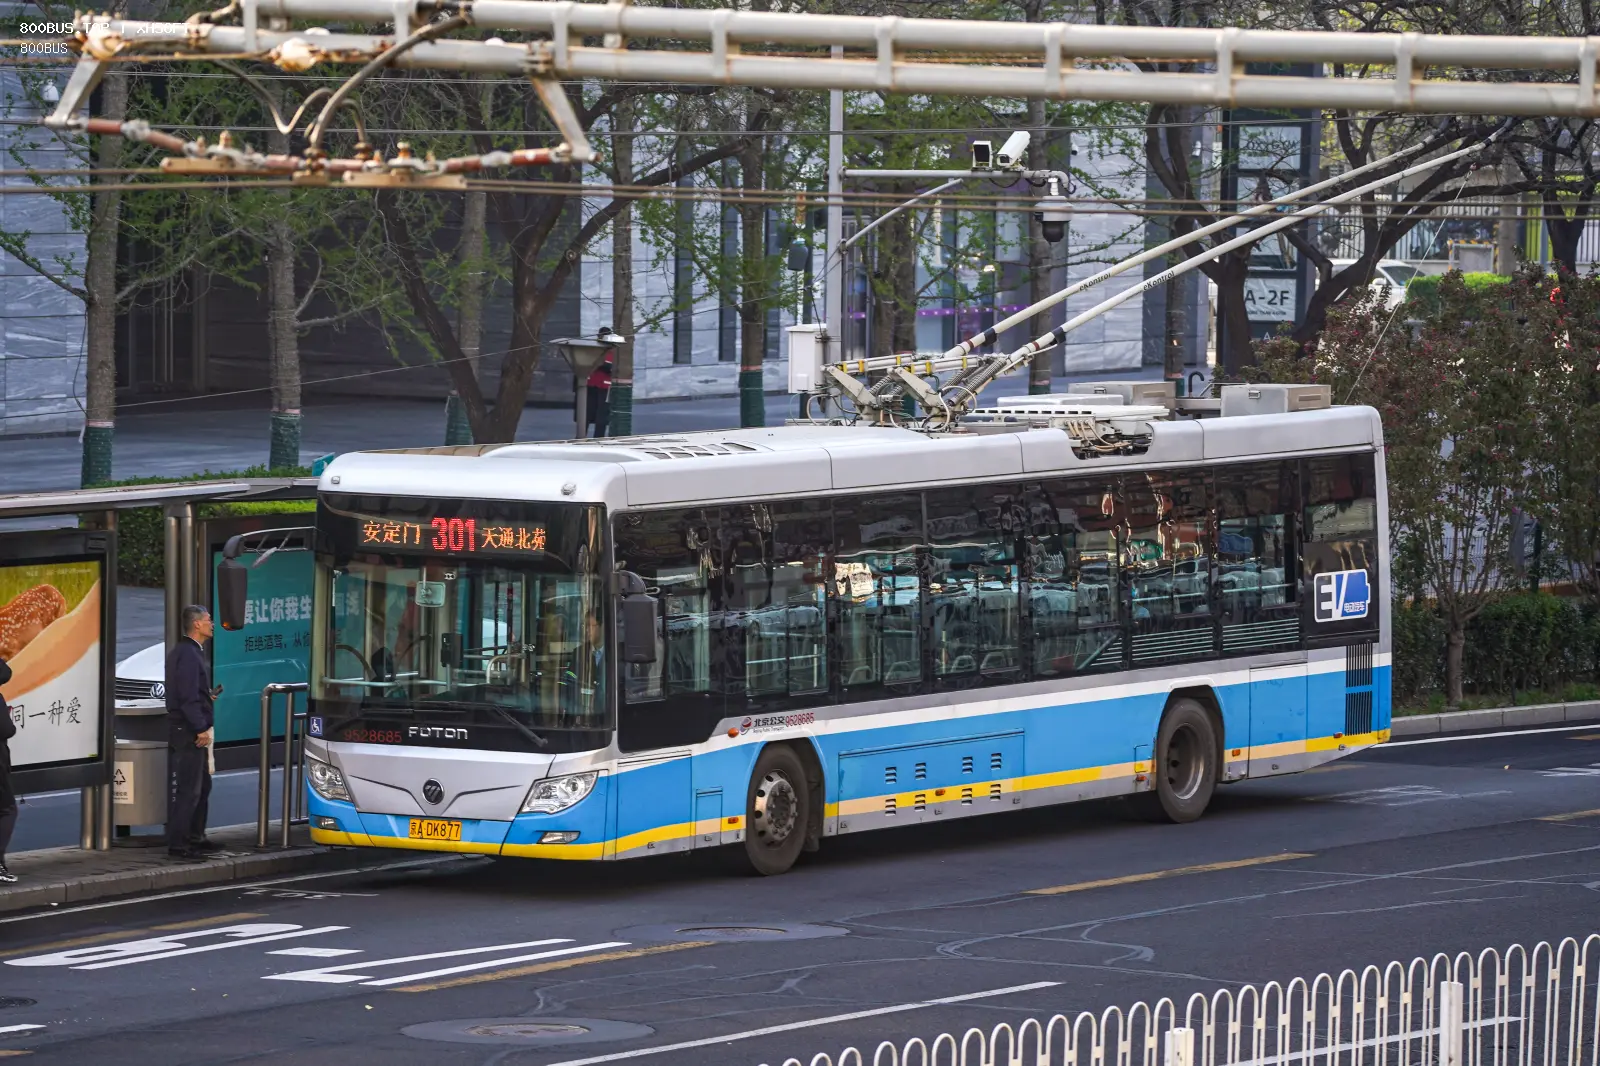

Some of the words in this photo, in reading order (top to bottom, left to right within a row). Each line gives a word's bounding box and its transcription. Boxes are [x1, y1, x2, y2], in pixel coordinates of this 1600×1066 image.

[1143, 270, 1175, 292] eKontrol
[1244, 289, 1290, 306] A-2F
[362, 520, 420, 544] 安定门
[431, 517, 476, 551] 301
[481, 526, 546, 551] 天通北苑
[11, 697, 82, 729] 同一种爱
[753, 715, 785, 728] 北京公交
[785, 712, 815, 728] 9528685
[344, 729, 403, 743] 9528685
[408, 726, 469, 740] FOTON
